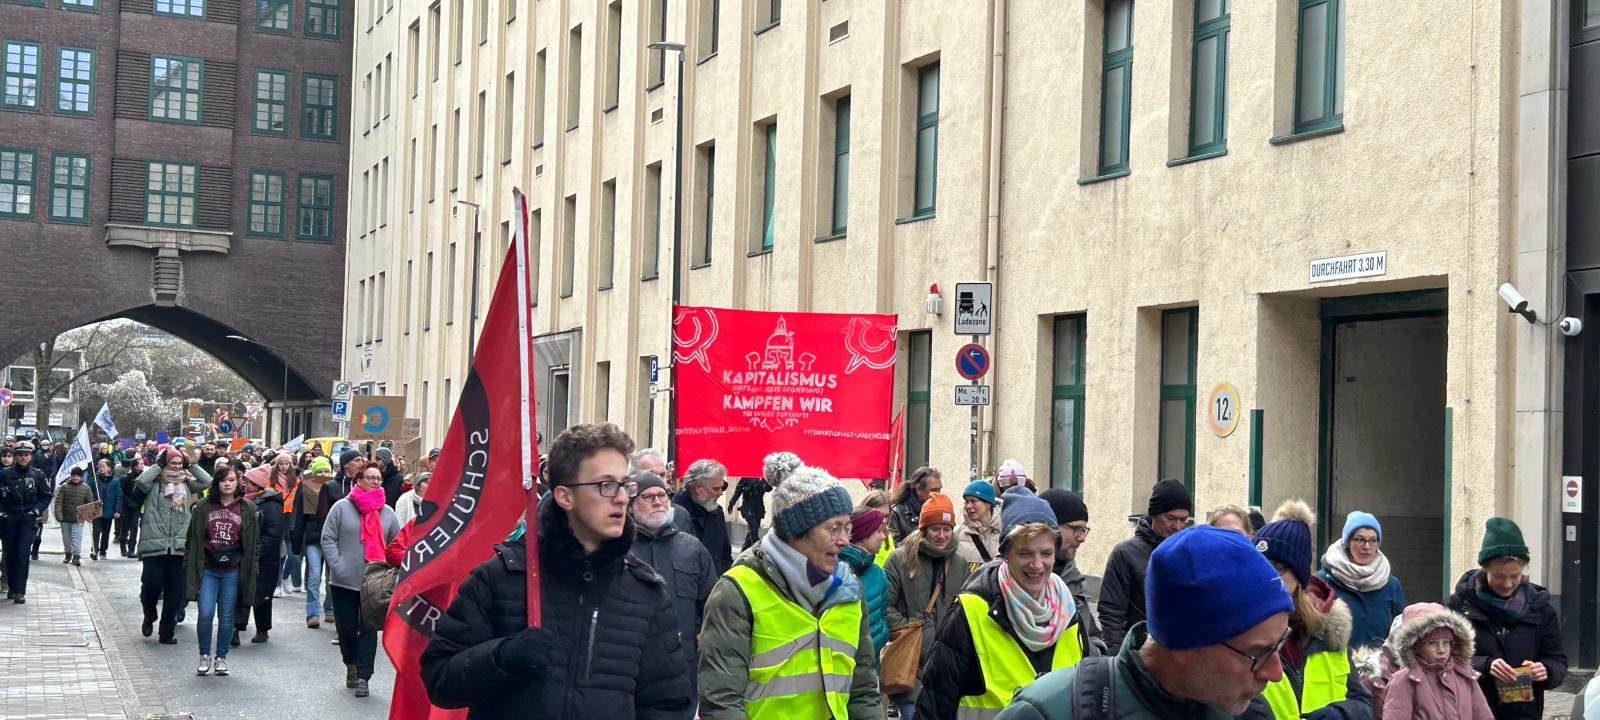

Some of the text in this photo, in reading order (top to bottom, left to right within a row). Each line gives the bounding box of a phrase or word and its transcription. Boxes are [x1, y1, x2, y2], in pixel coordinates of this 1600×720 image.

[1311, 255, 1384, 278] DURCHFAHRT 3,30 M
[958, 317, 987, 326] Ladezone
[651, 360, 657, 380] P
[722, 370, 838, 389] KAPITALISMUS
[971, 396, 980, 404] 20
[982, 396, 987, 404] h
[977, 387, 986, 395] Fr
[336, 402, 344, 413] P
[722, 391, 833, 412] KÄMPFEN WIR
[215, 521, 233, 541] H
